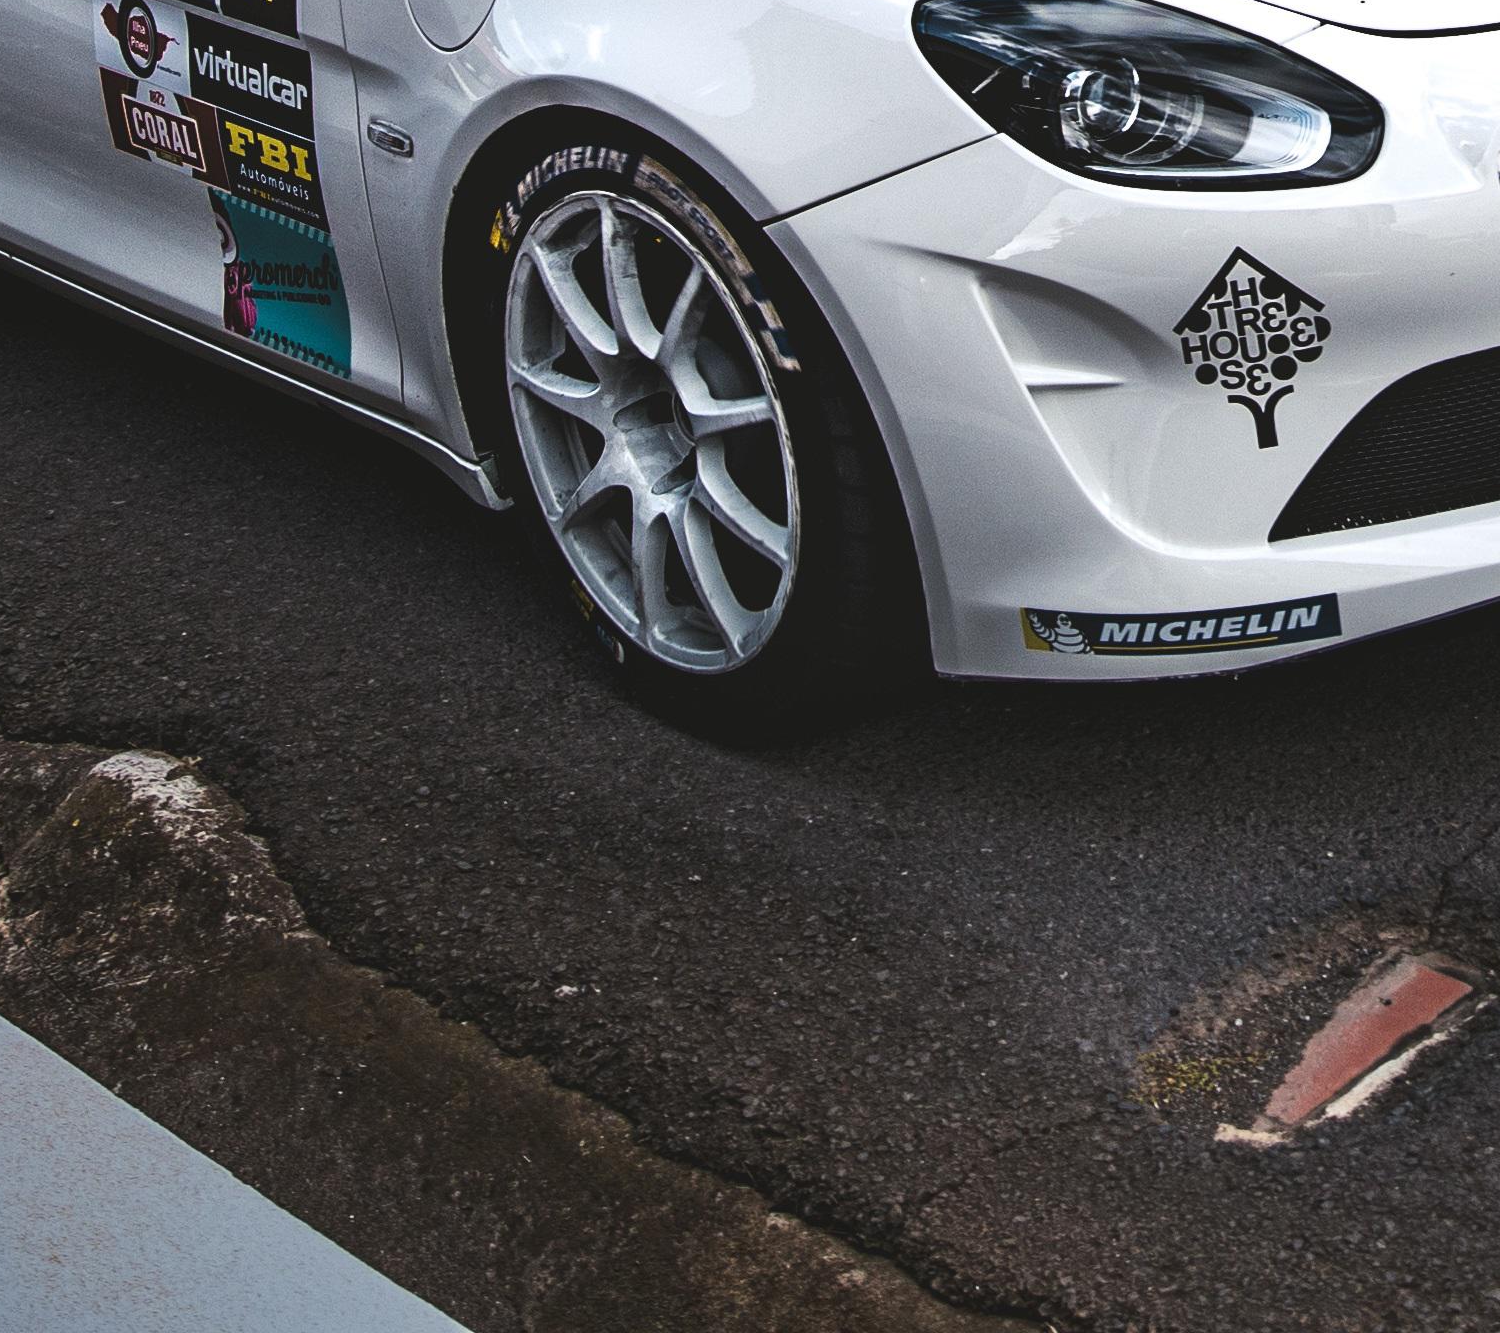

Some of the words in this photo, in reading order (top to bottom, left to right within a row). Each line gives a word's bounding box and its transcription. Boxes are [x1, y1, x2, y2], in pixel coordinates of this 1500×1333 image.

[193, 44, 309, 110] virtualcar
[132, 106, 198, 160] CORAL
[225, 120, 313, 182] FBI
[239, 163, 311, 201] Automóveis
[517, 145, 629, 209] MICHELIN
[1099, 603, 1323, 645] MICHELIN
